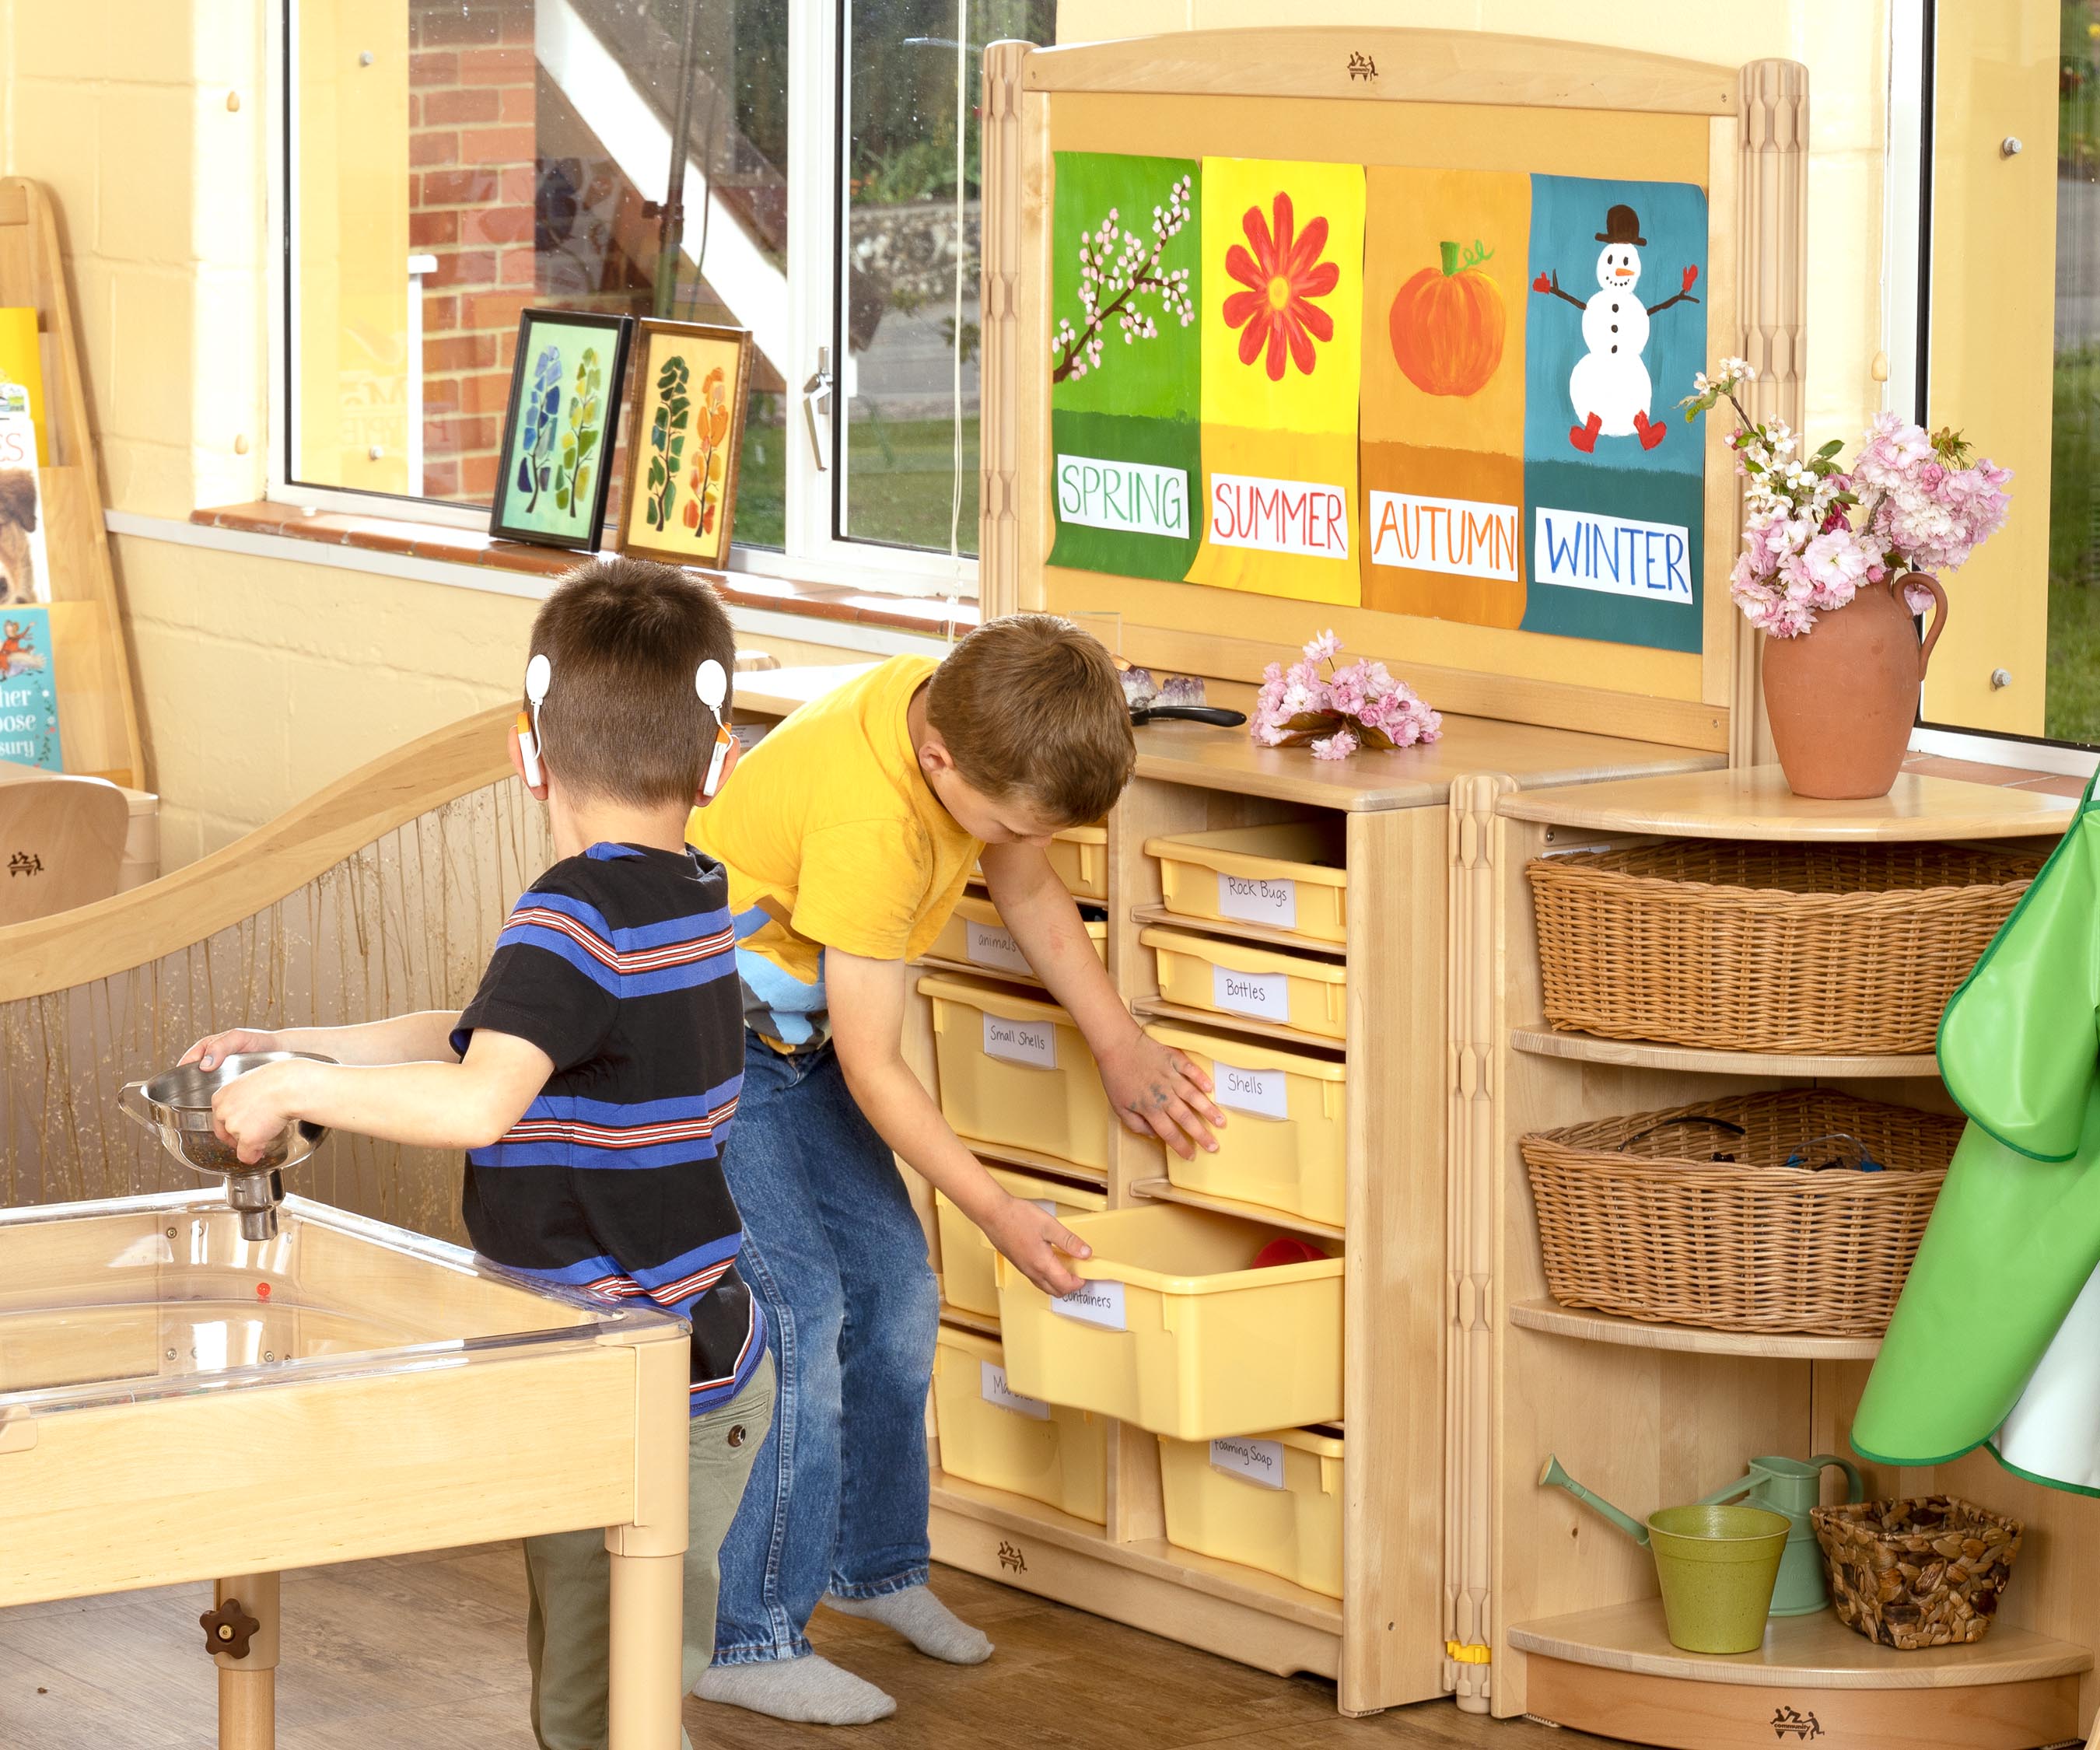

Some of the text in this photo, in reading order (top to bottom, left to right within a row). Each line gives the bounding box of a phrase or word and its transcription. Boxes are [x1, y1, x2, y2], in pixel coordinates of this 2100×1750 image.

[1059, 465, 1181, 529] SPRING
[1213, 483, 1345, 551] SUMMER
[1373, 500, 1516, 572] AUTUMN
[1545, 517, 1689, 593] WINTER
[1227, 877, 1287, 908] Rock Bugs
[978, 933, 1017, 953] animals
[1225, 978, 1266, 1002] Bottles
[989, 1024, 1045, 1051] Small Shells
[1227, 1073, 1263, 1095] Shells
[1250, 1445, 1273, 1472] Soap
